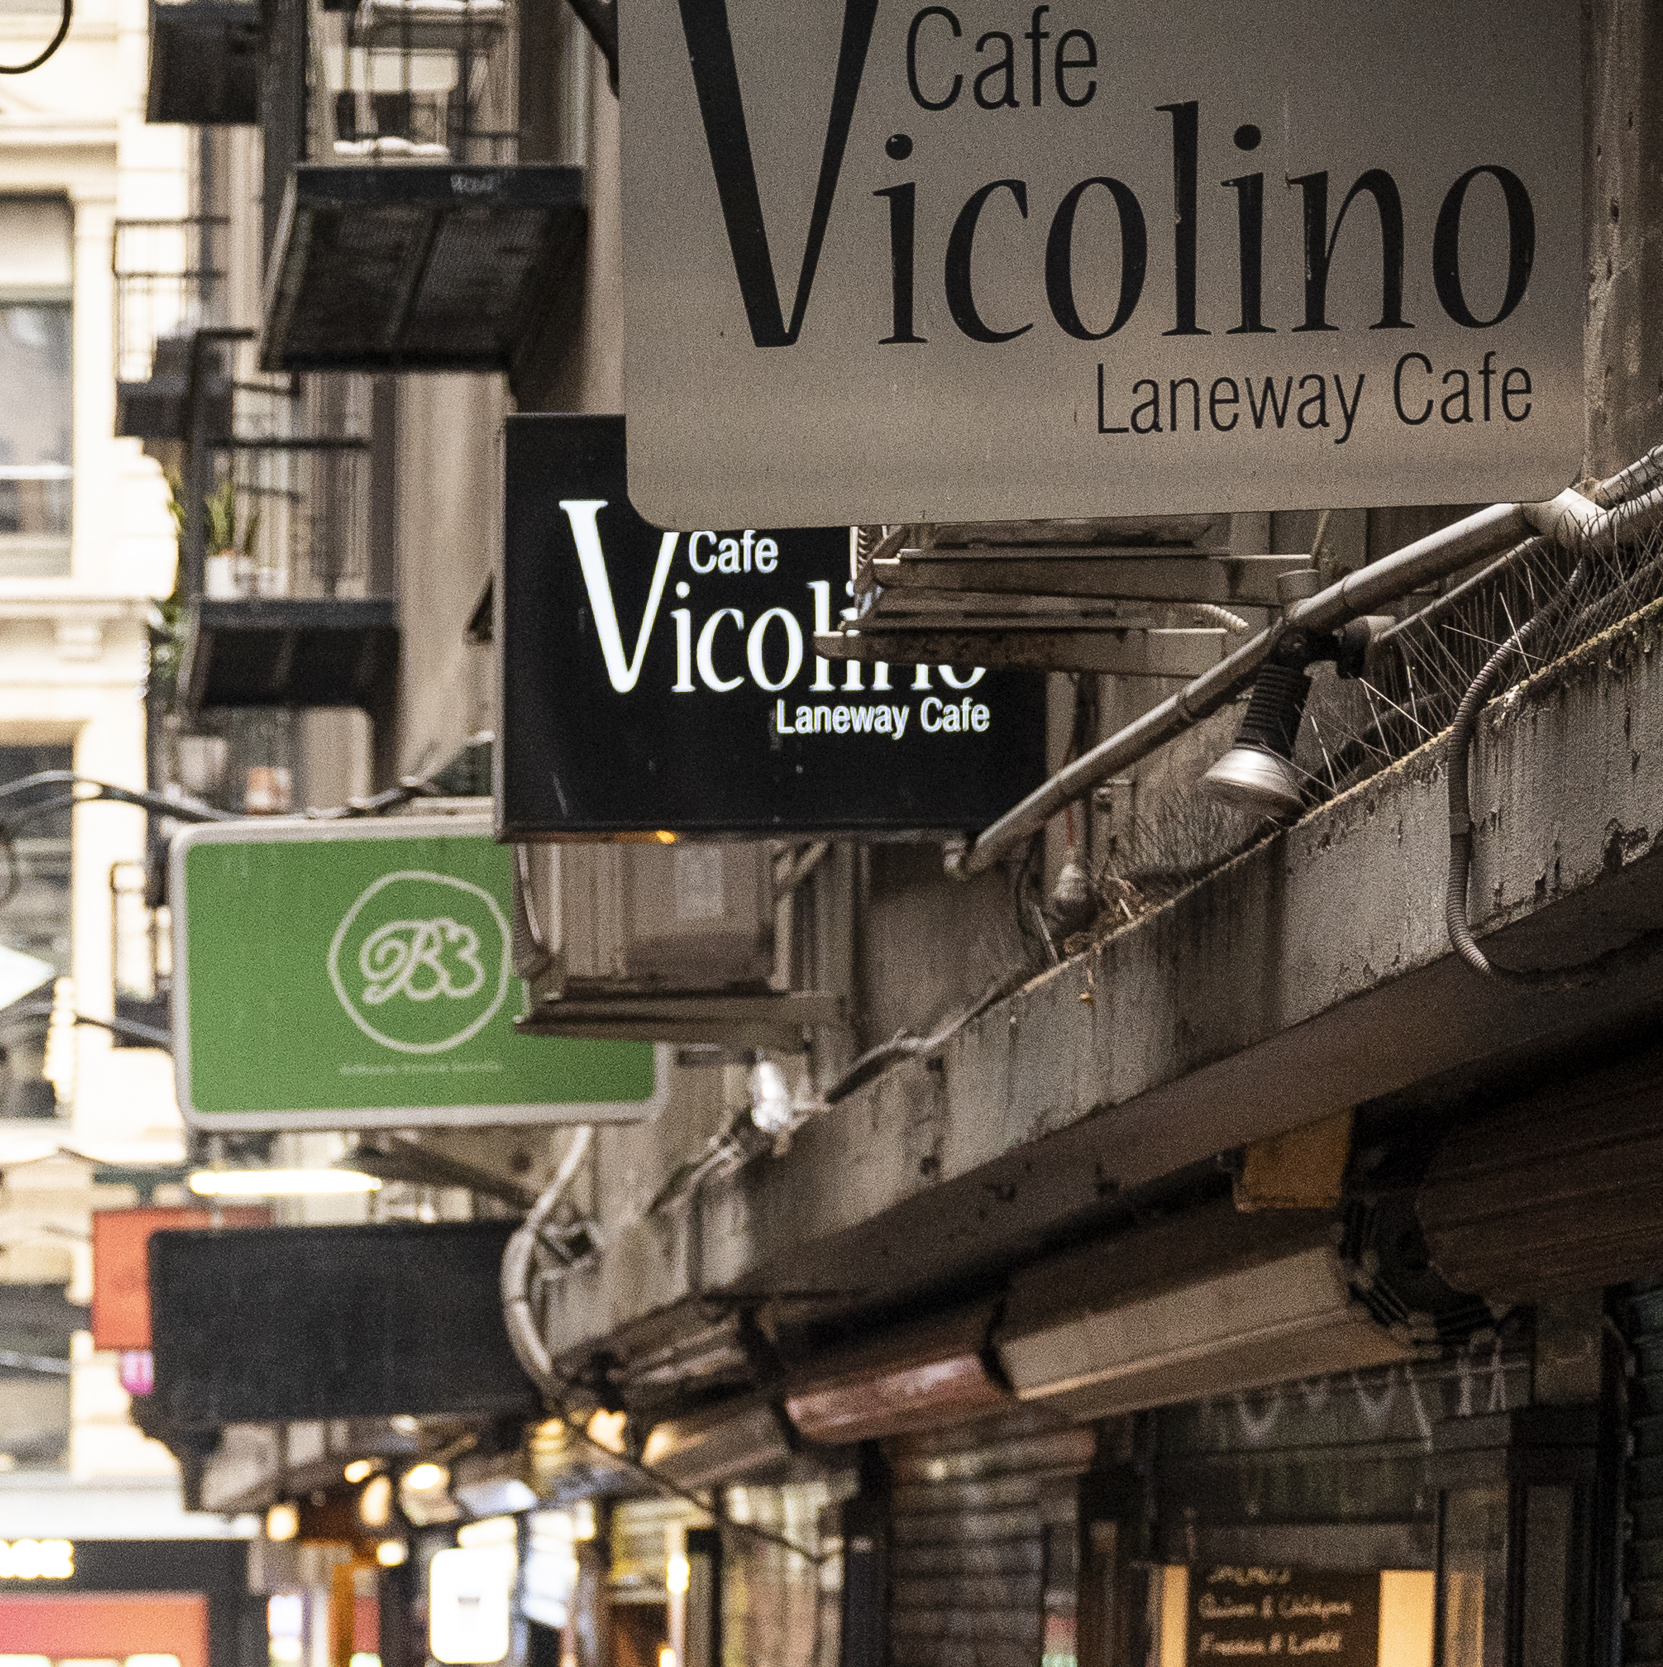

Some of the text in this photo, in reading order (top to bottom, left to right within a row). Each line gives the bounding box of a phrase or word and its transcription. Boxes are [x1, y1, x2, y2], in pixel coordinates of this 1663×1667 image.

[906, 5, 1098, 111] Cafe
[678, 0, 1536, 348] Vicolino
[1097, 353, 1533, 444] Laneway Cafe
[689, 531, 779, 573] Cafe
[776, 697, 990, 740] Laneway Cafe
